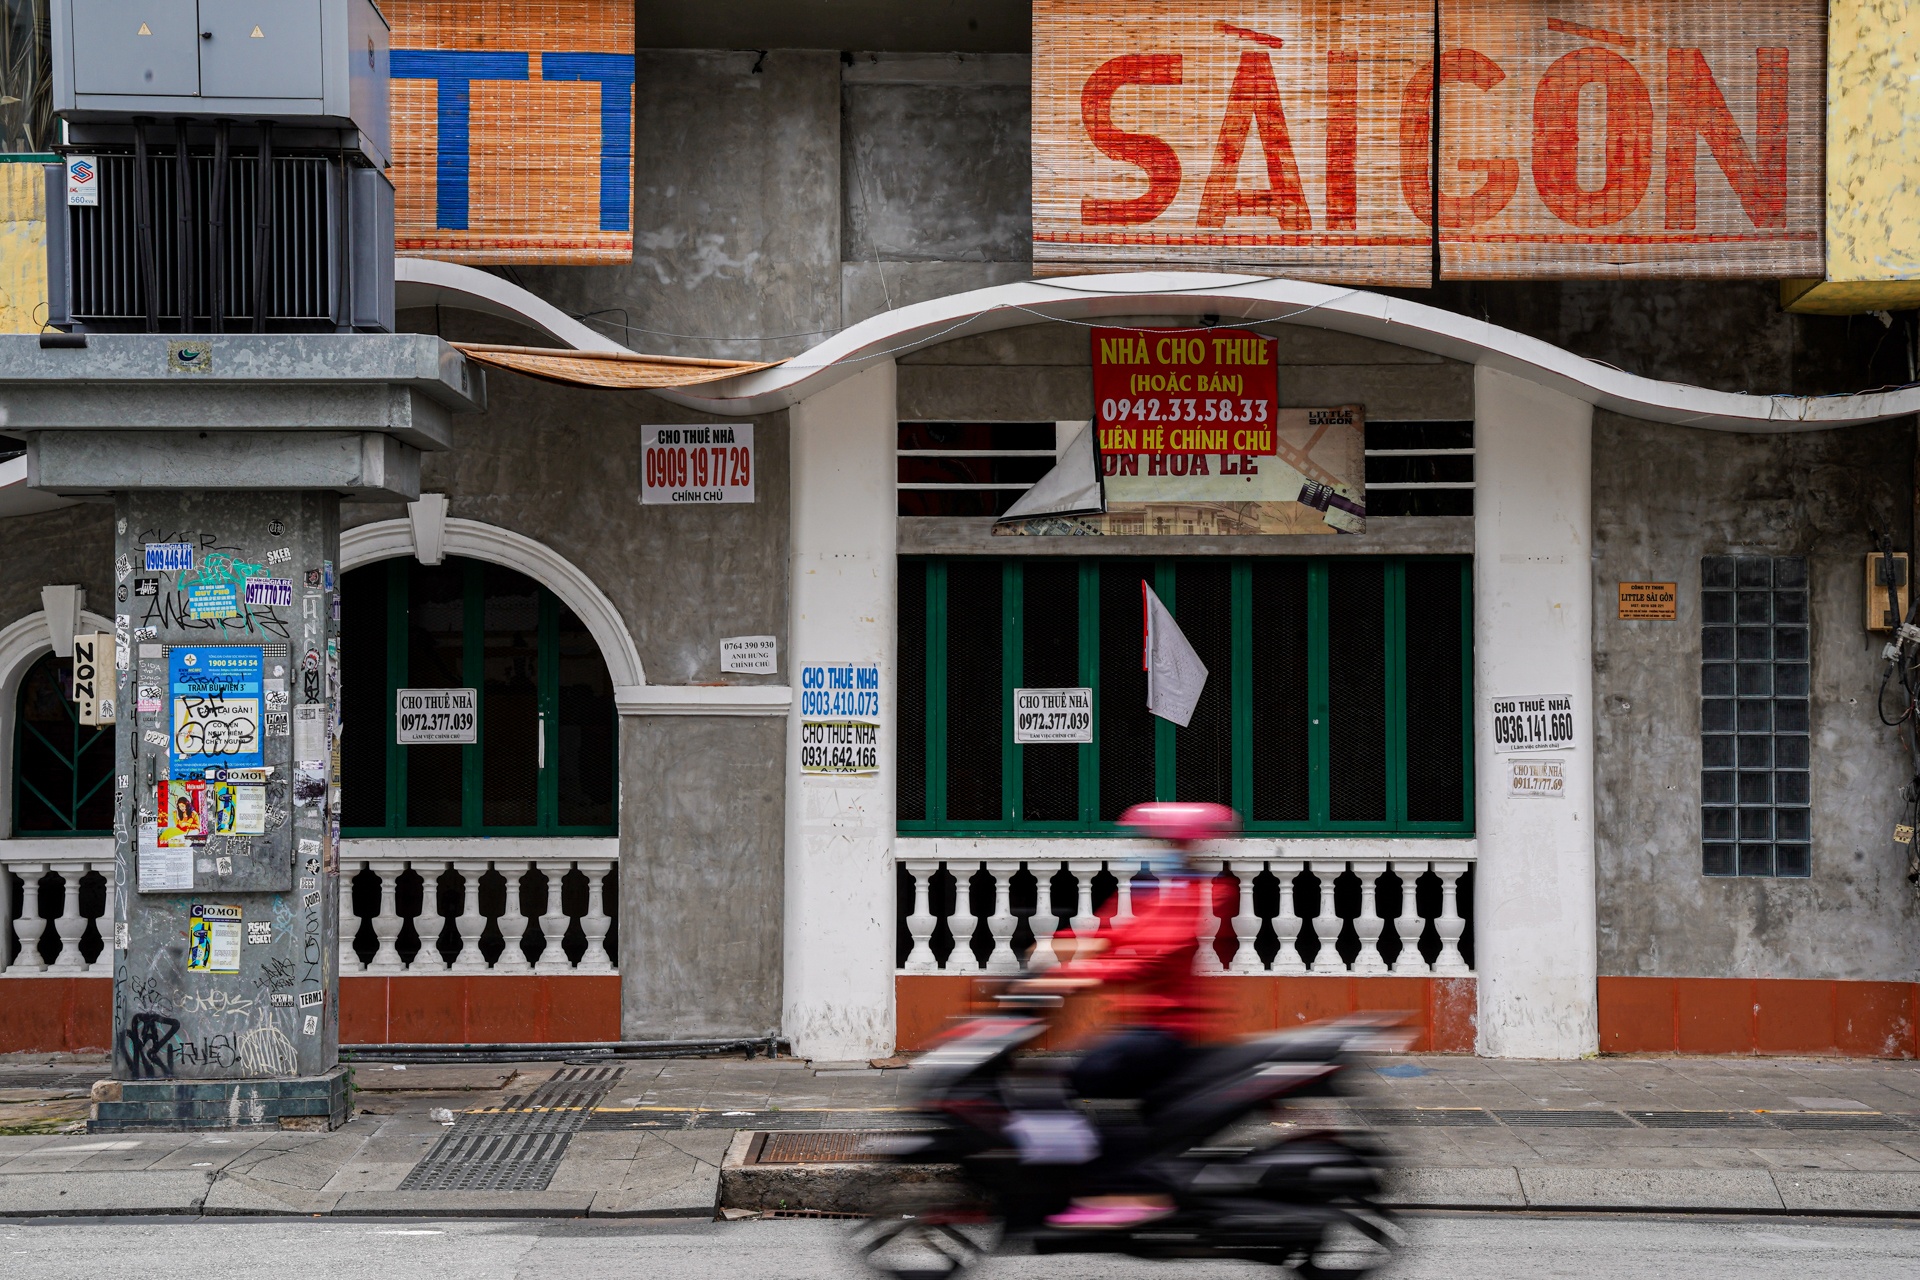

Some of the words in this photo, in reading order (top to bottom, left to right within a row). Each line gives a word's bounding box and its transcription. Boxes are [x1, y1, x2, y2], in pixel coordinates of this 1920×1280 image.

[1080, 22, 1358, 232] SÀI
[1399, 17, 1791, 231] GÒN
[70, 196, 84, 204] 560
[1100, 332, 1150, 365] NHÀ
[1156, 338, 1206, 365] CHO
[1130, 371, 1192, 396] (HOẶC
[1197, 371, 1244, 396] BÁN)
[1102, 398, 1269, 422] 0942.33.58.33
[1308, 410, 1352, 418] LITTLE
[658, 430, 681, 444] CHO
[682, 427, 711, 444] THUÊ
[712, 426, 735, 444] NHÀ
[1100, 424, 1137, 450] LIÊN
[1142, 425, 1165, 454] HỆ
[1169, 424, 1228, 450] CHÍNH
[1233, 424, 1271, 450] CHỦ
[646, 447, 688, 488] 0909
[671, 490, 701, 502] CHÍNH
[703, 488, 723, 501] CHỦ
[266, 547, 291, 562] SKER
[1621, 594, 1644, 602] LITTLE
[1646, 592, 1658, 602] SÀI
[1660, 592, 1674, 602] GÒN
[724, 642, 743, 650] 0764
[744, 642, 759, 650] 390
[760, 640, 774, 649] 930
[730, 660, 754, 668] CHÍNH
[802, 667, 824, 689] CHO
[828, 662, 854, 689] THUÊ
[856, 662, 879, 690] NHÀ
[402, 696, 422, 710] CHO
[424, 692, 450, 709] THUÊ
[452, 692, 473, 709] NHÀ
[802, 691, 878, 716] 0903.410.073
[1020, 696, 1040, 708] CHO
[1042, 692, 1066, 708] THUÊ
[1069, 692, 1089, 708] NHÀ
[1494, 702, 1516, 714] CHO
[1518, 698, 1545, 712] THUÊ
[1548, 696, 1571, 711] NHÀ
[401, 713, 474, 731] 0972.377.039
[1020, 712, 1090, 730] 0972.377.039
[1494, 713, 1574, 744] 0936.141.660
[802, 724, 824, 744] CHO
[826, 720, 852, 744] THUÊ
[802, 746, 876, 767] 0931.642.166
[1514, 764, 1529, 776] CHO
[1548, 762, 1563, 777] NHÀ
